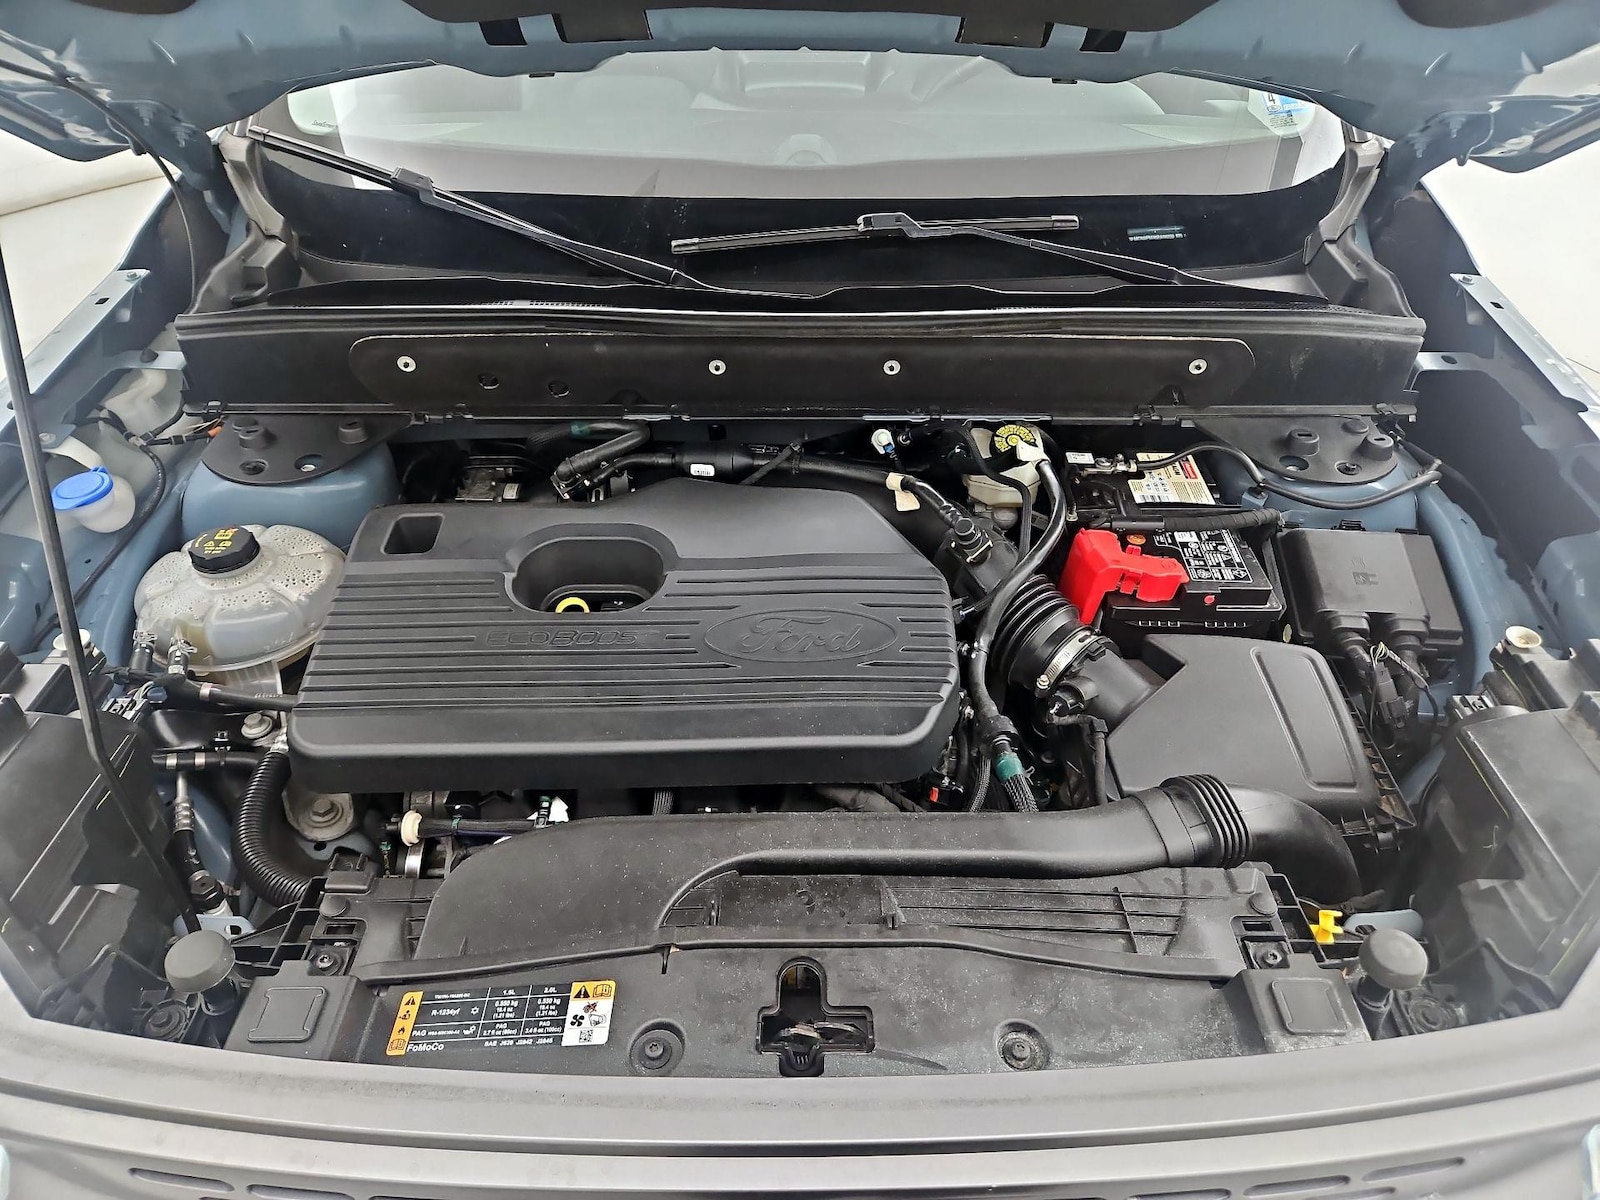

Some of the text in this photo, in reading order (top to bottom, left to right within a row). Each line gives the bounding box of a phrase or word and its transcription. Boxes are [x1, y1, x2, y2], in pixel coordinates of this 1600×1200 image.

[486, 630, 659, 647] ECOBOOS
[742, 615, 863, 653] Ford
[554, 997, 561, 1005] kg
[431, 1007, 461, 1016] R-1234yf
[407, 1042, 444, 1052] FoMoCo
